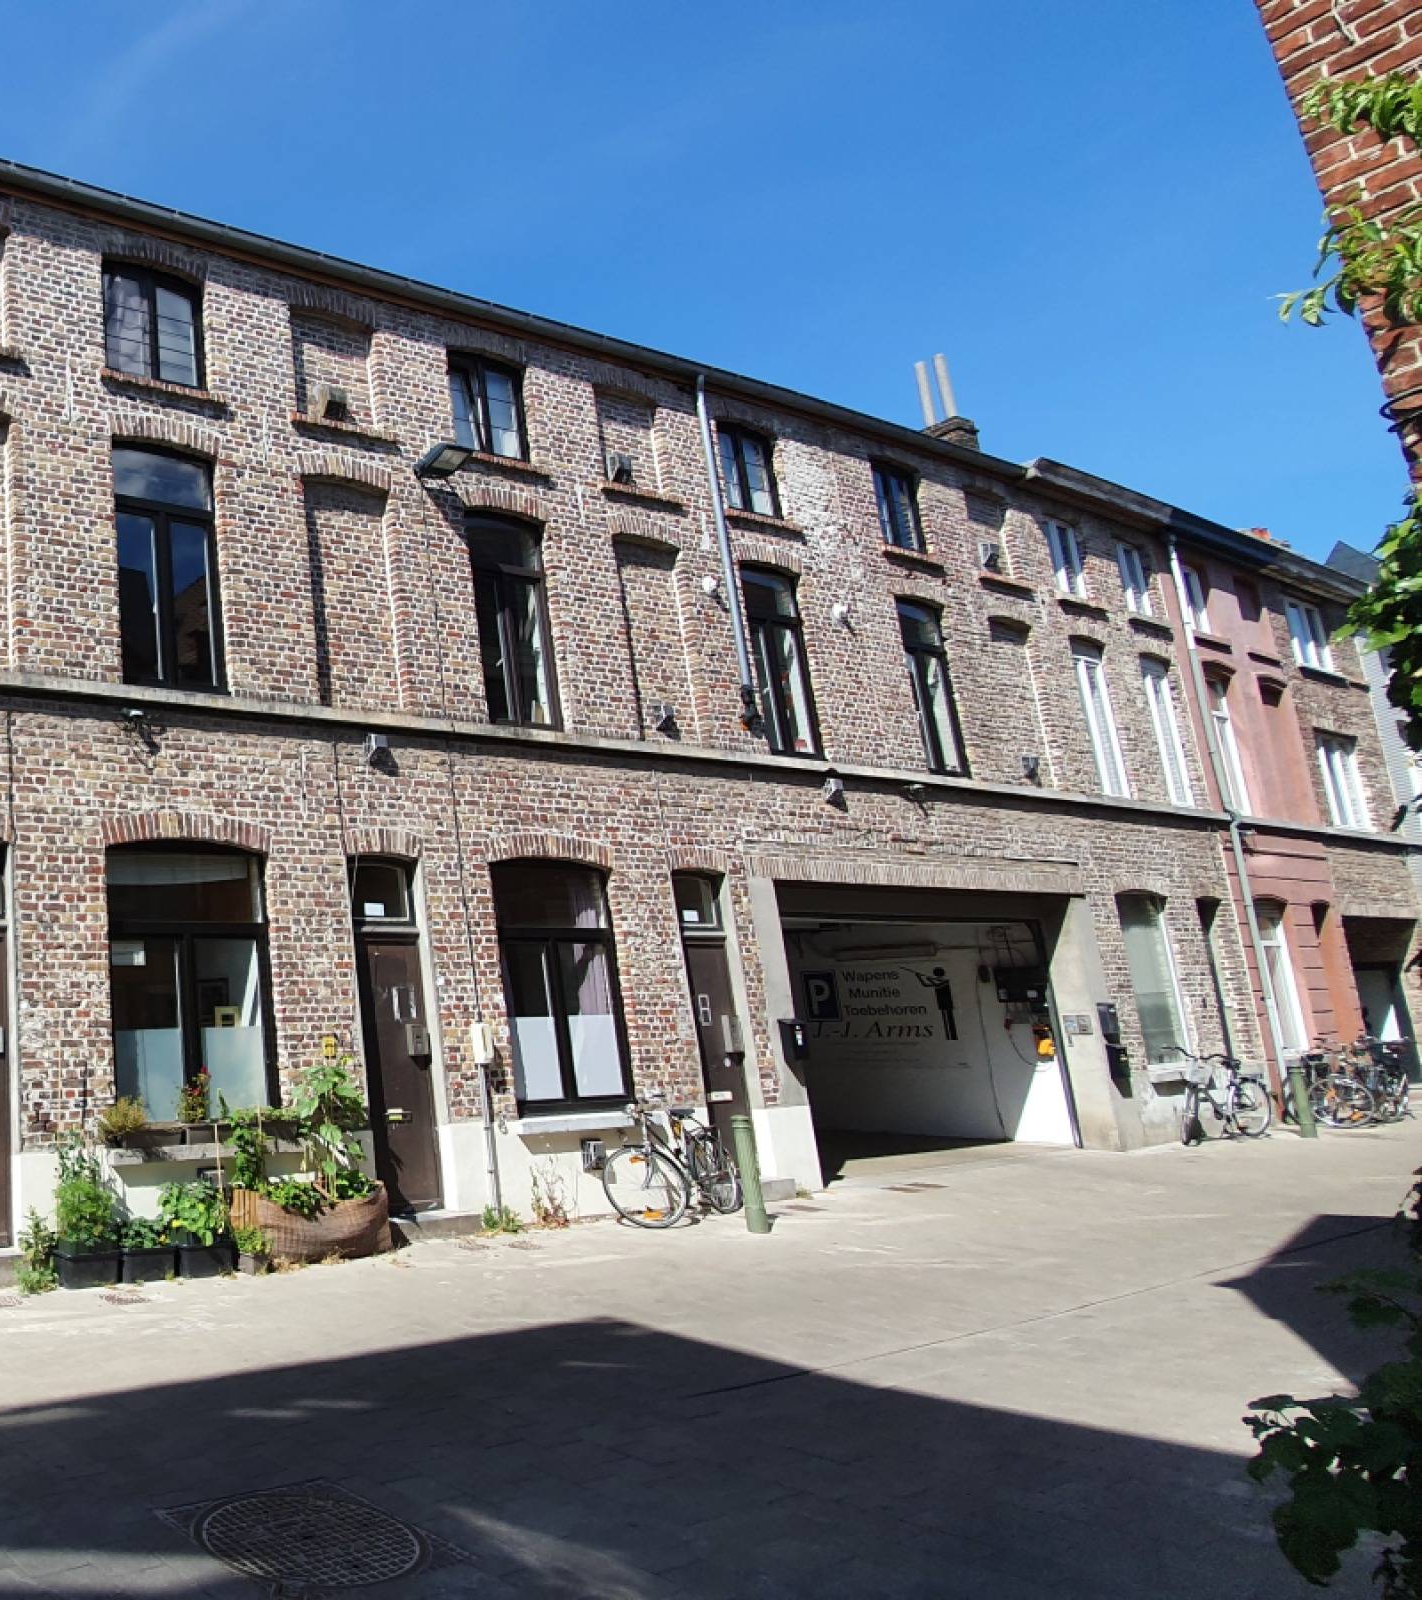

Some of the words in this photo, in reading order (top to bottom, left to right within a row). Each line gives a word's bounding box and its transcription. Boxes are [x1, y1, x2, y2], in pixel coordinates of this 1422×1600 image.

[842, 969, 900, 983] Wapens
[806, 979, 829, 1016] P
[849, 986, 901, 999] Munitie
[844, 1004, 927, 1016] Toebehoren
[864, 1020, 935, 1038] Arms
